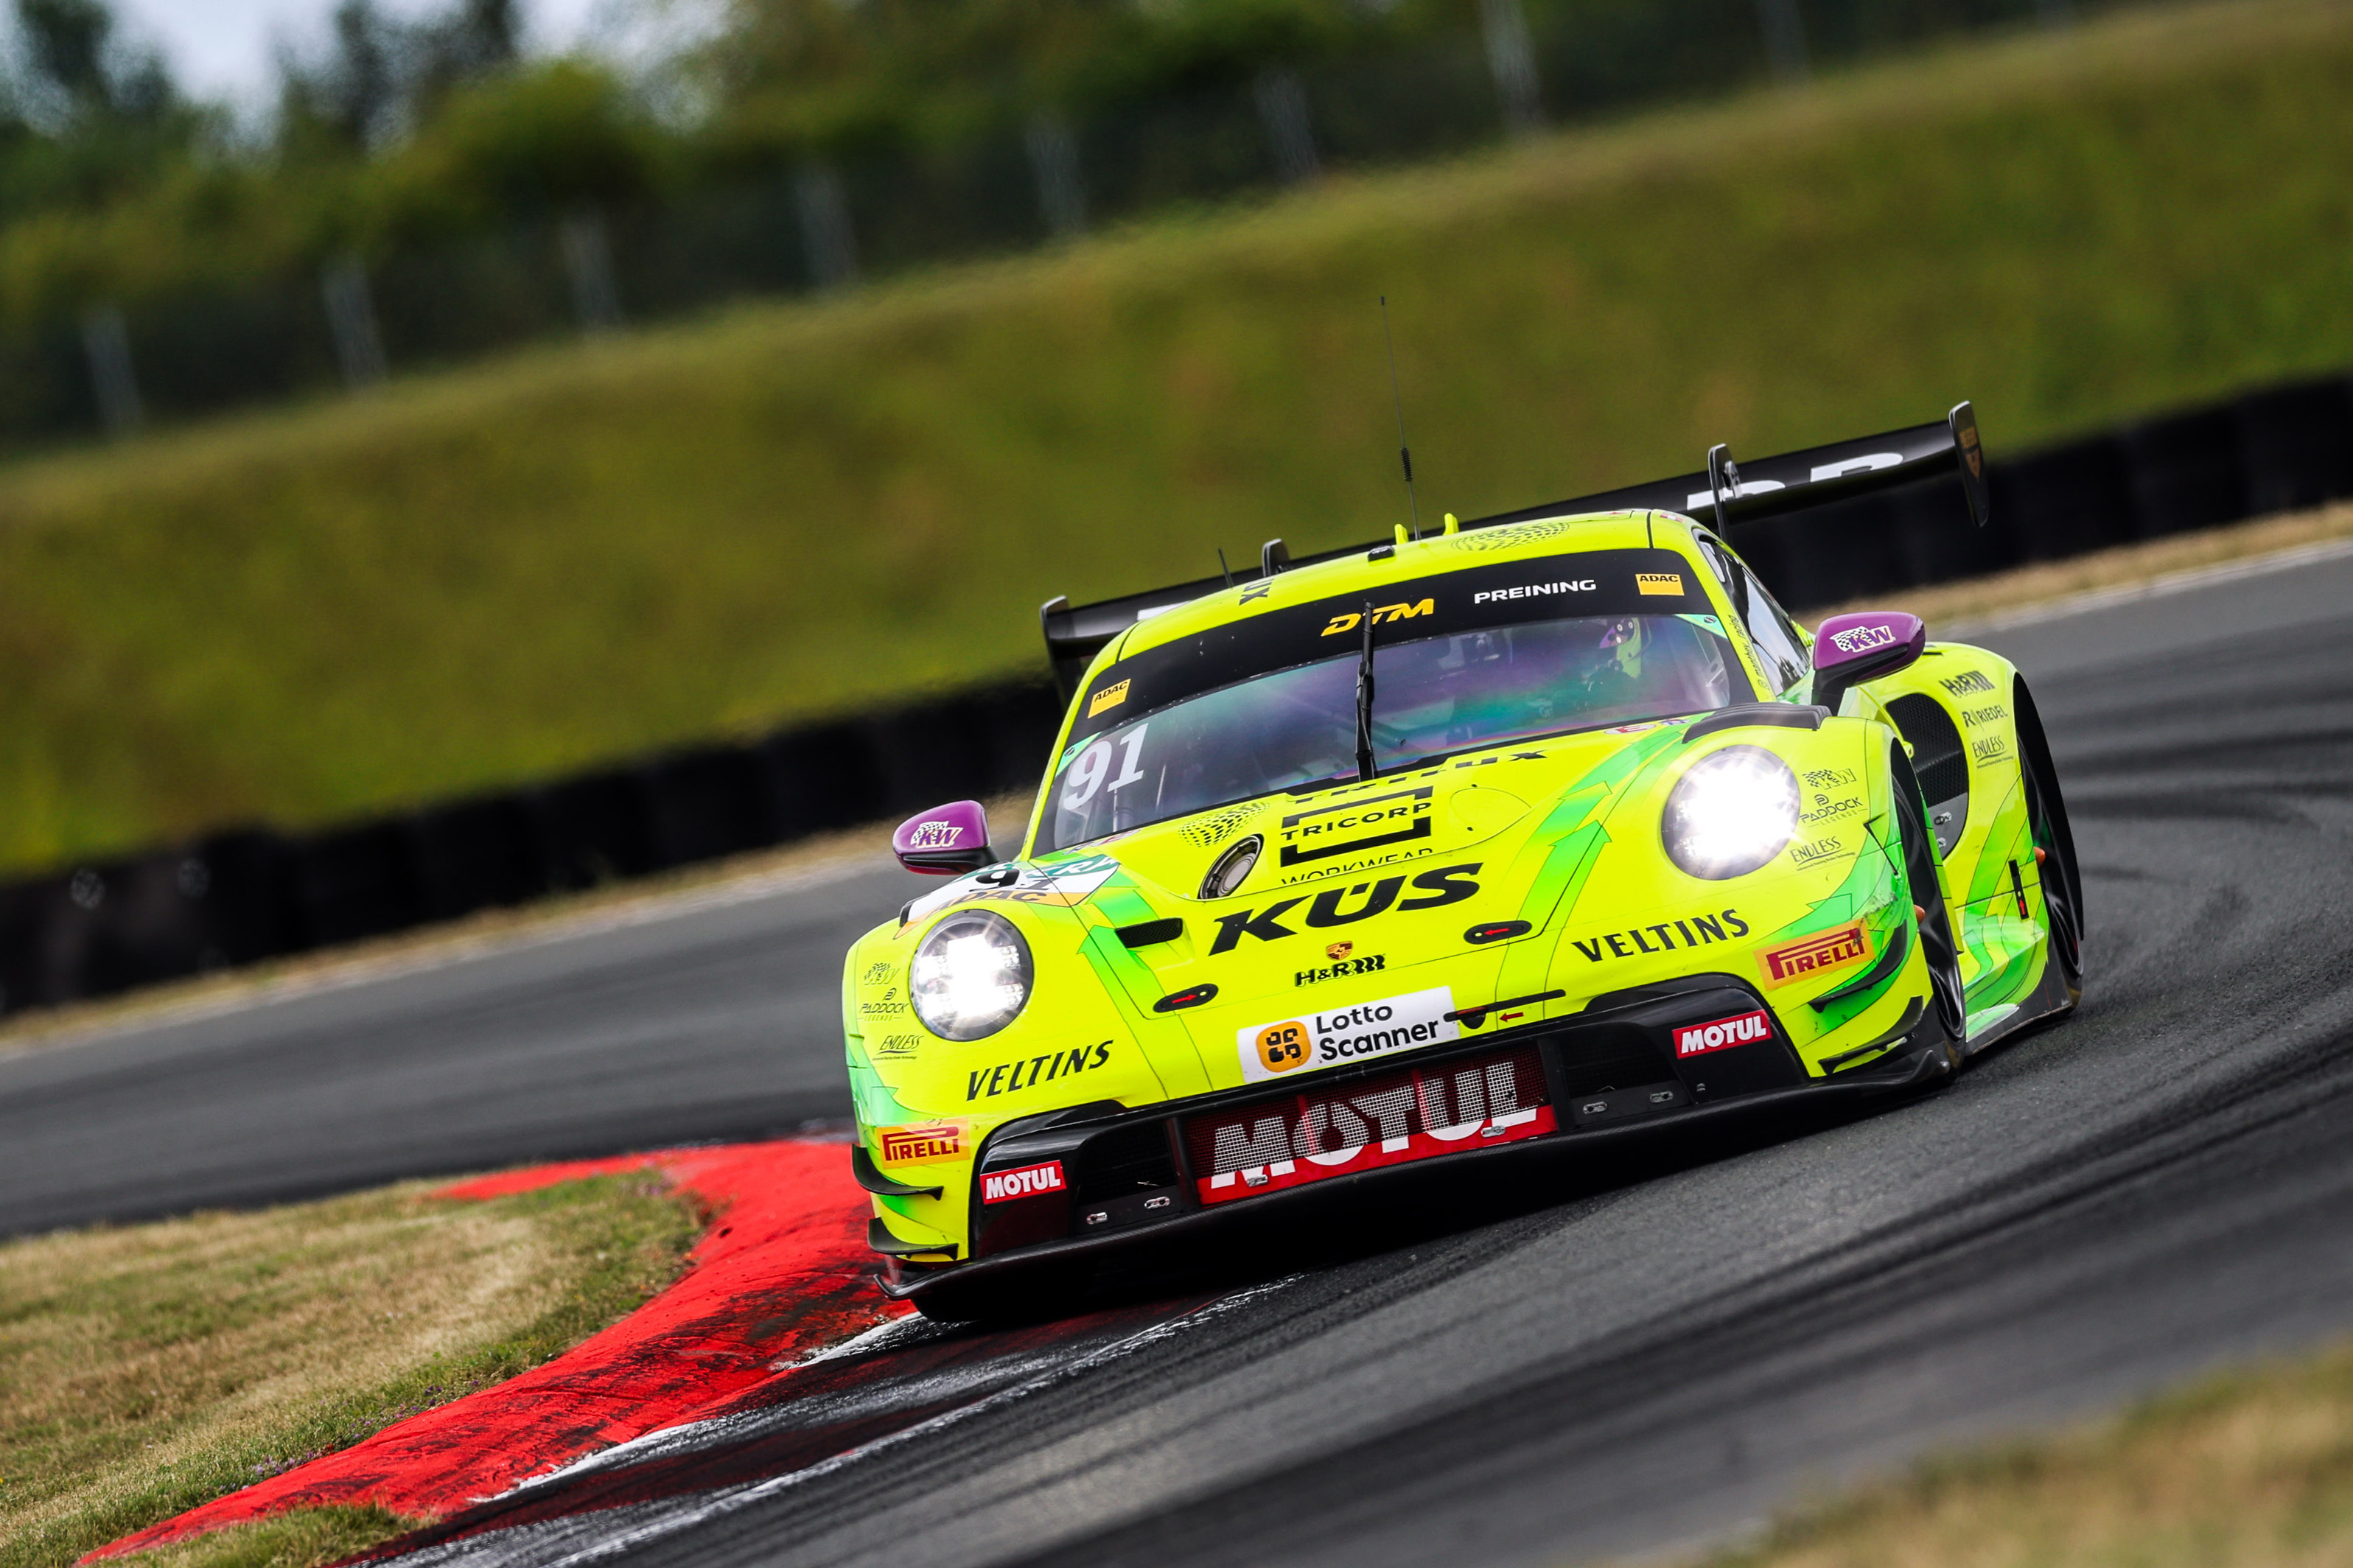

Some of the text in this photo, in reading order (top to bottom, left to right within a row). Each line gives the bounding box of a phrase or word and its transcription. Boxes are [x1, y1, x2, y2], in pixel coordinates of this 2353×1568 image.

[1474, 579, 1596, 603] PREINING
[1639, 573, 1679, 583] ADAC
[1321, 598, 1434, 637] DTM
[1846, 624, 1896, 653] KW
[1094, 679, 1128, 703] ADAC
[1976, 704, 2008, 724] RIEDEL
[1972, 735, 2004, 757] ENDLESS
[1063, 723, 1148, 811] 91
[1281, 802, 1432, 841] TRICORP
[1799, 797, 1863, 824] PADDOCK
[1820, 810, 1858, 825] LEGENDS
[1790, 836, 1842, 863] ENDLESS
[1207, 862, 1484, 956] KÜS
[1571, 909, 1749, 962] VELTINS
[1766, 928, 1865, 981] PIRELLI
[859, 1003, 909, 1014] PADDOCK
[1315, 1003, 1393, 1035] Lotto
[879, 1035, 924, 1050] ENDLESS
[1319, 1019, 1438, 1060] Scanner
[1681, 1015, 1766, 1054] MOTUL
[966, 1040, 1113, 1101] VELTINS
[1211, 1061, 1537, 1189] MOTUL
[883, 1126, 959, 1161] PIRELLI
[986, 1166, 1061, 1200] MOTUL
